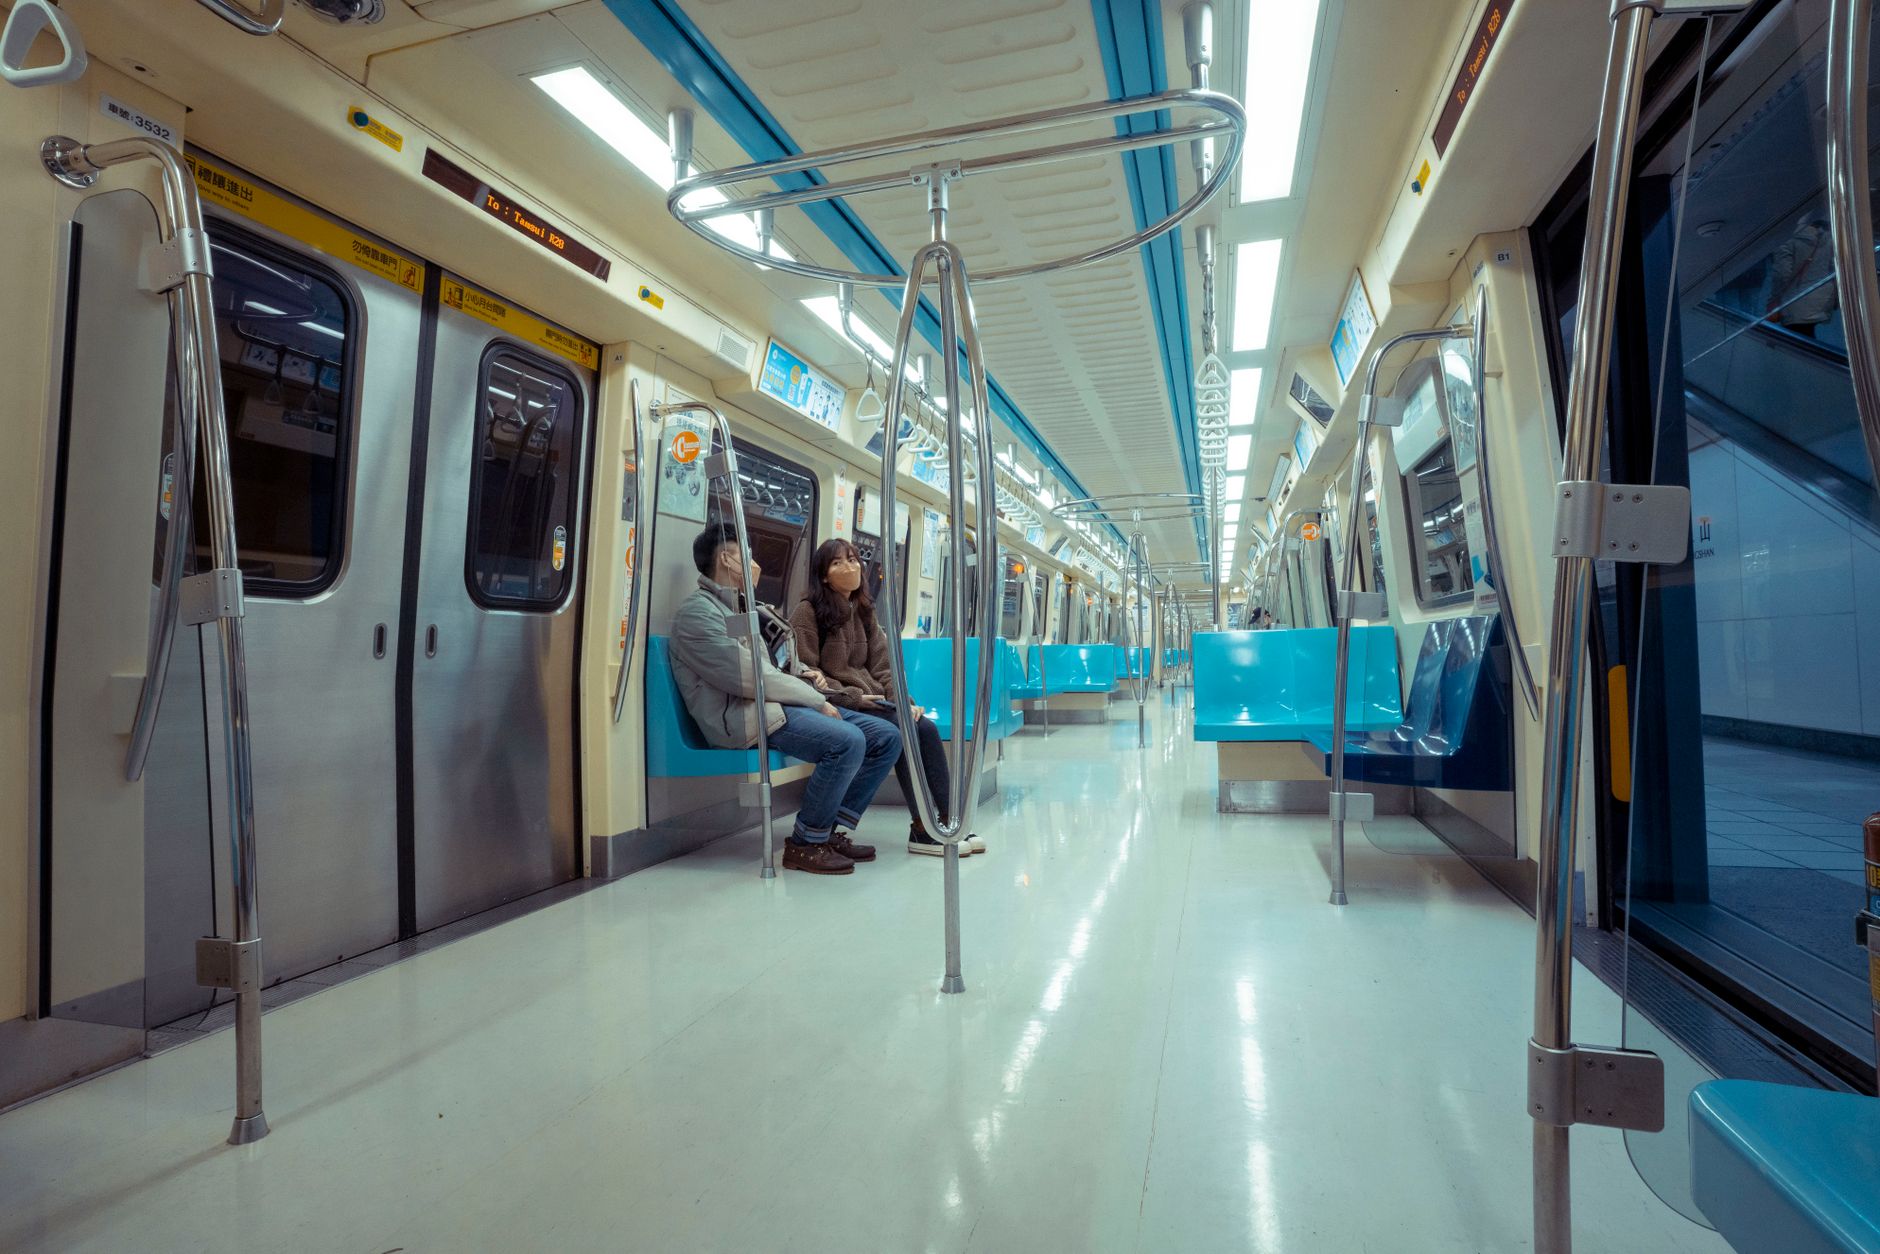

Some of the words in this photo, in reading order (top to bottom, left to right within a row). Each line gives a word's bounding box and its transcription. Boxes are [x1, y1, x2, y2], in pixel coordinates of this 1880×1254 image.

[1457, 89, 1467, 105] To
[1468, 36, 1489, 78] Tamsui
[197, 164, 253, 202] 禮讓進出
[486, 194, 500, 211] To
[513, 210, 546, 239] Tamsui
[548, 232, 566, 250] R28
[1497, 252, 1511, 262] B1
[614, 354, 624, 362] A1
